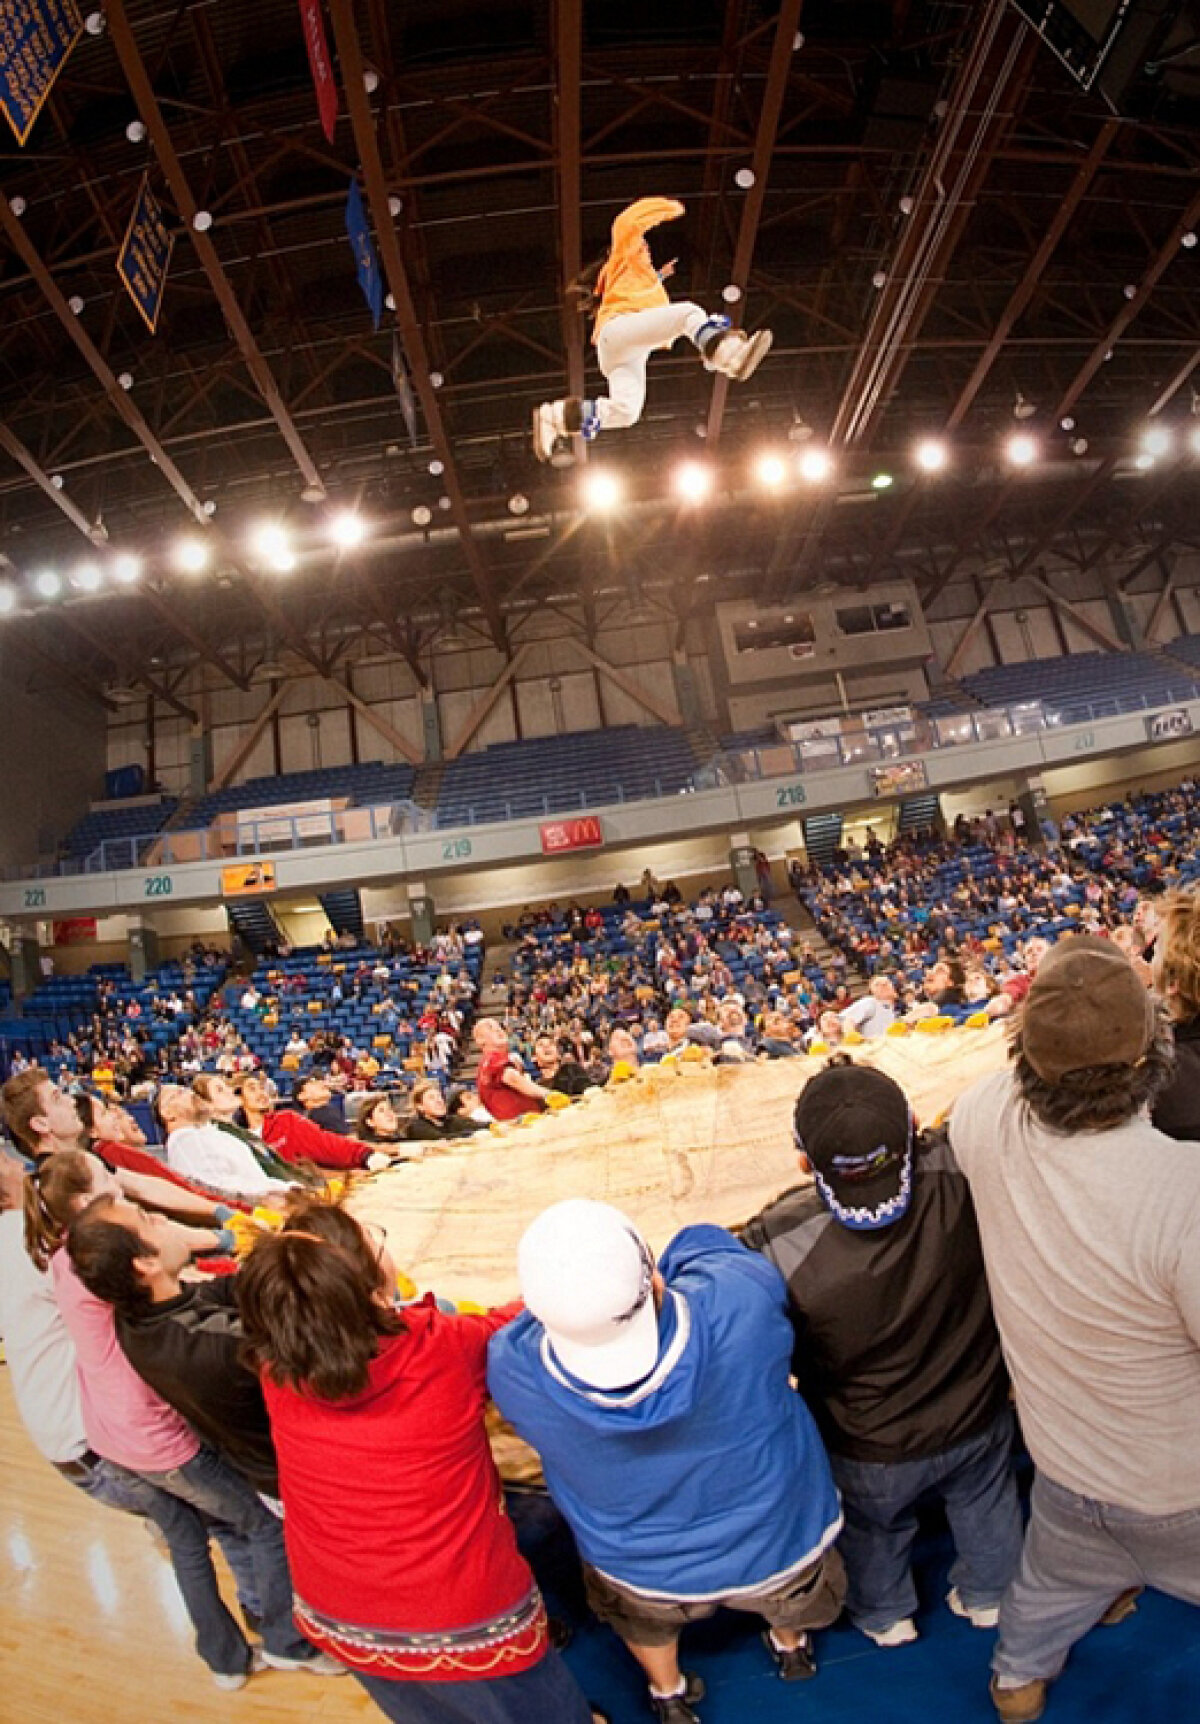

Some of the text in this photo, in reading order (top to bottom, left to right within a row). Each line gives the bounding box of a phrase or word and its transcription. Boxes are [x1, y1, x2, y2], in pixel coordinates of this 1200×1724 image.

[776, 785, 807, 807] 218
[442, 837, 472, 860] 219
[144, 875, 172, 896] 220
[24, 887, 46, 907] 221
